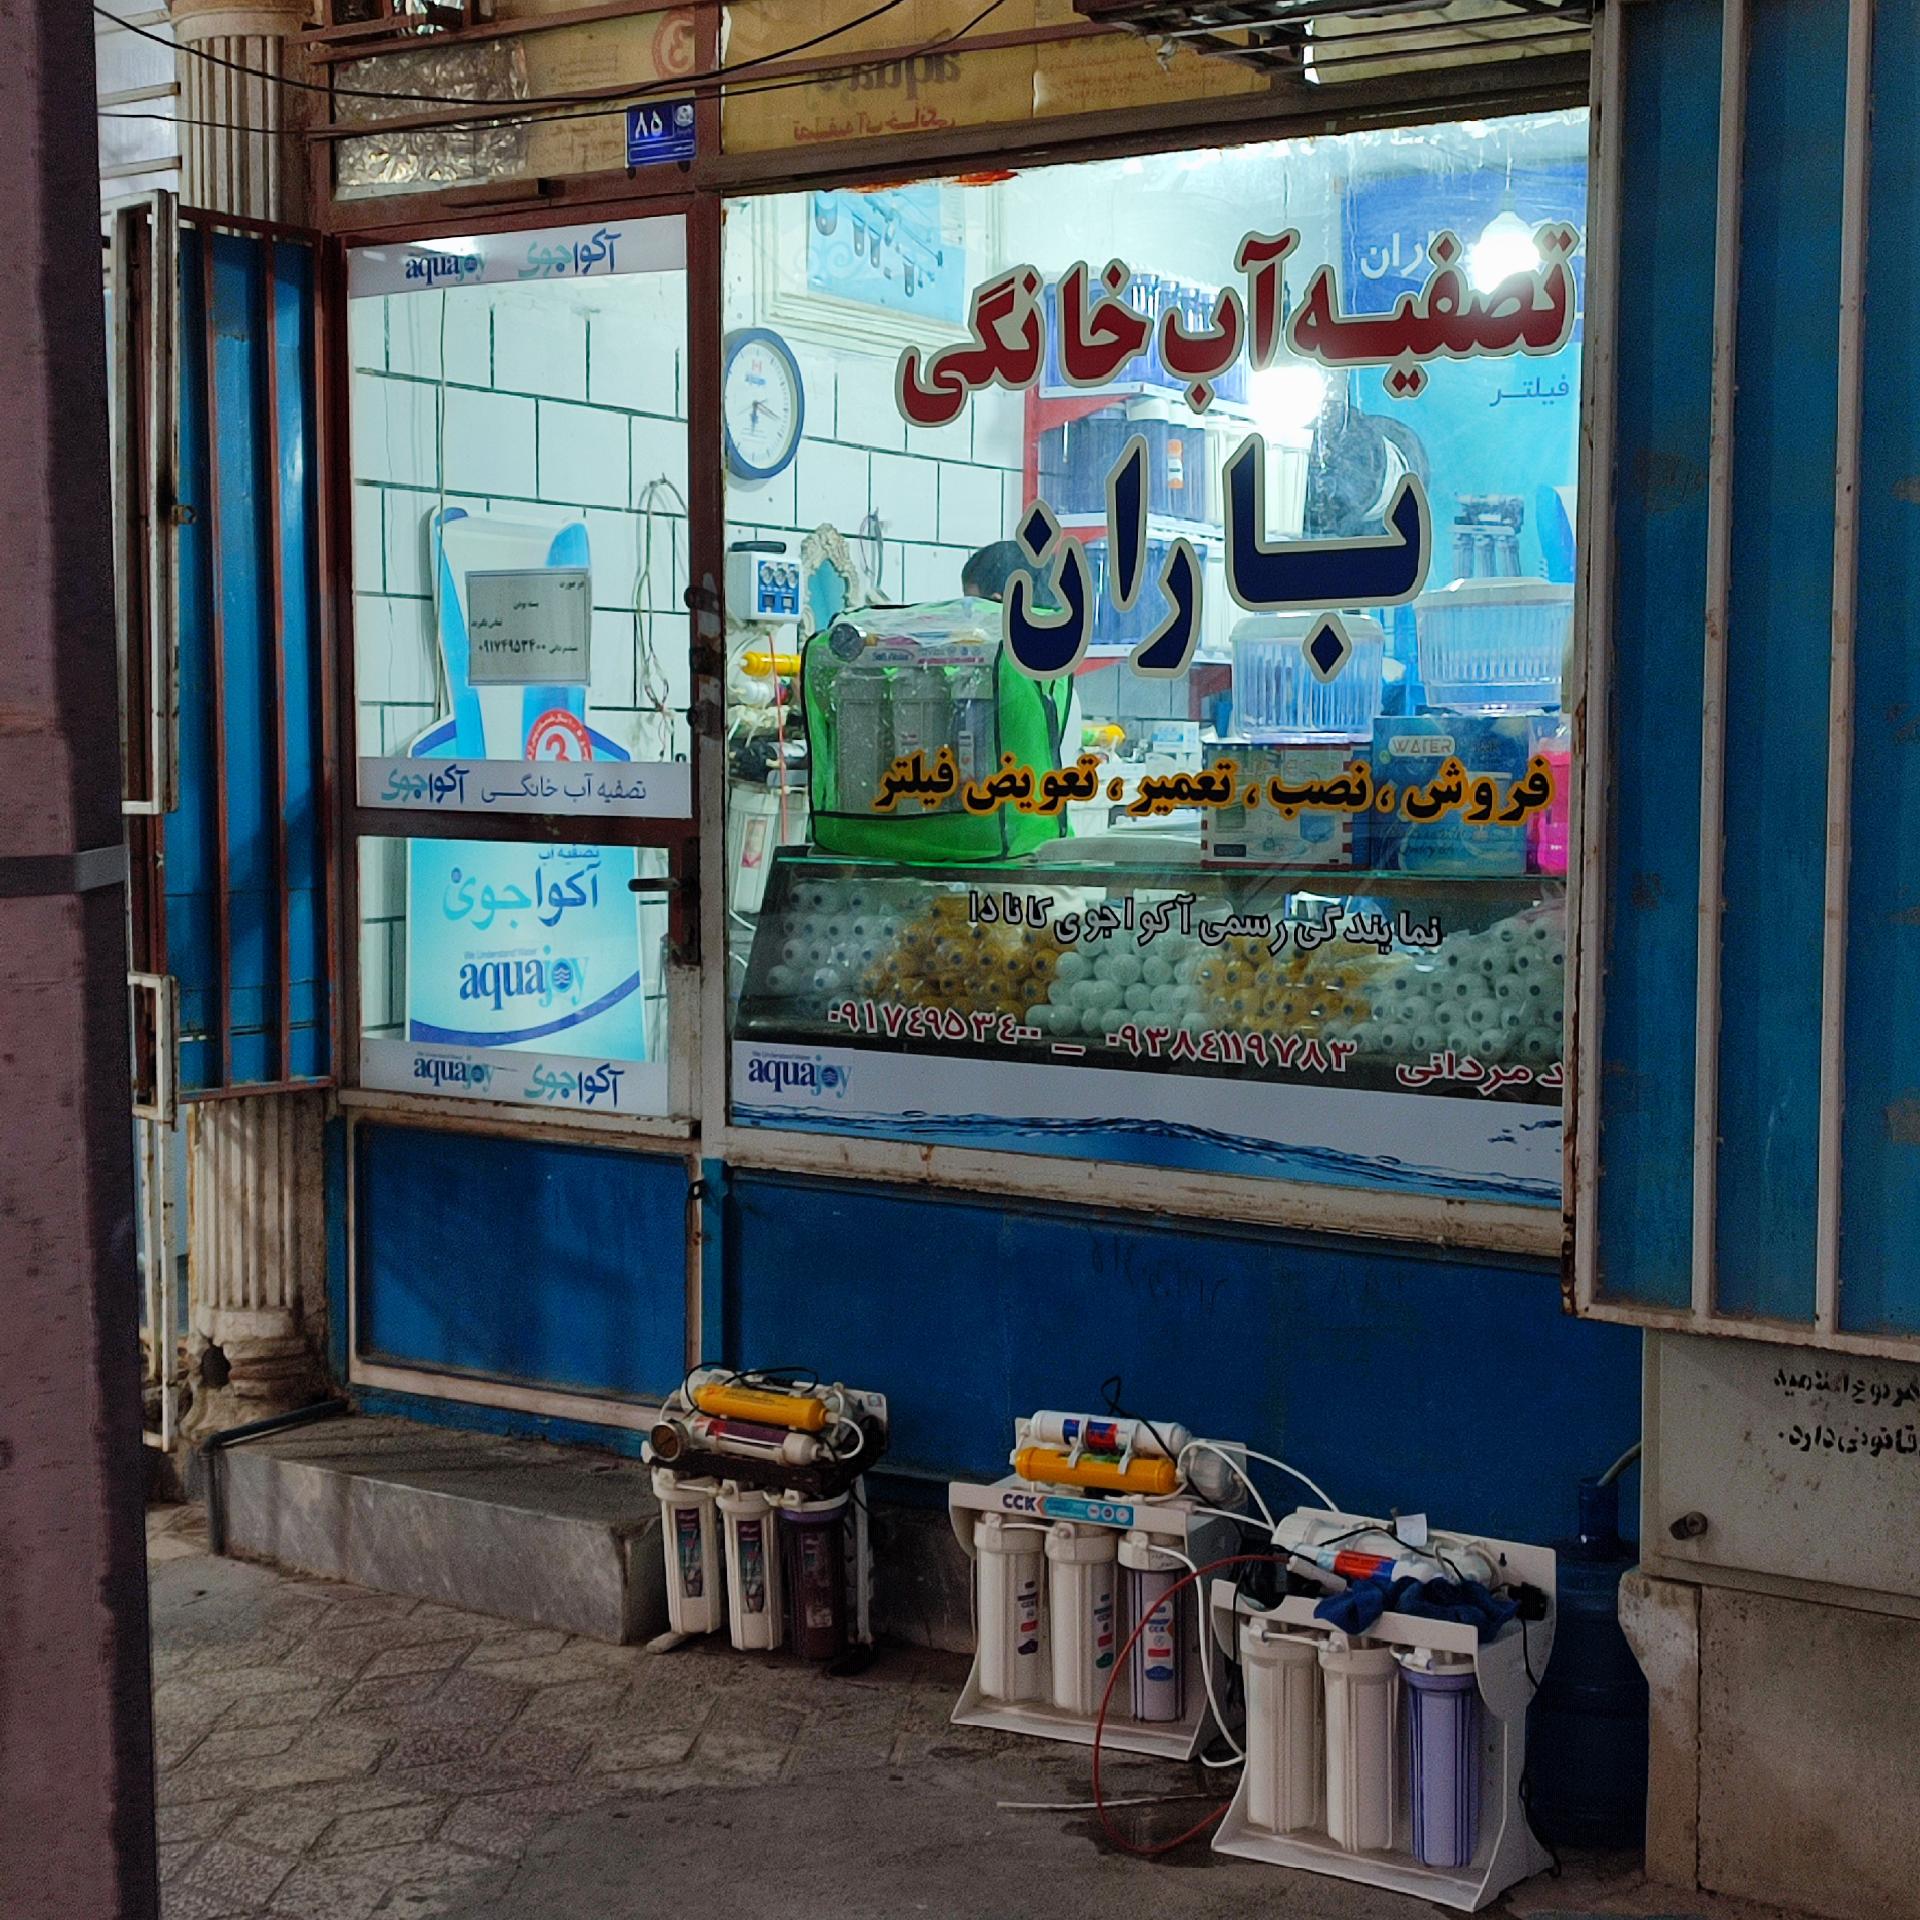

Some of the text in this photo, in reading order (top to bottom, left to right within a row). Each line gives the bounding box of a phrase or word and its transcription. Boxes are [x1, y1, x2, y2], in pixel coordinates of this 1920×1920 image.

[635, 110, 662, 139] ۸۵
[896, 220, 1580, 427] تصفیه آب خانگی
[1489, 374, 1570, 407] فیلتر
[1003, 433, 1431, 683] باران
[481, 775, 557, 804] خانگی
[564, 773, 594, 804] آب
[597, 780, 647, 803] تصفیه
[874, 745, 960, 813] فیلتر
[962, 752, 1101, 815] تعویض
[969, 890, 1054, 928] کانادا
[1199, 914, 1288, 955] رسمی
[1294, 906, 1443, 955] نمایندگی
[459, 945, 589, 1011] aquajoy
[413, 1054, 493, 1093] aquajoy
[749, 1055, 851, 1098] aquajoy
[1396, 1049, 1533, 1096] مردانی
[1003, 1493, 1037, 1512] CCK
